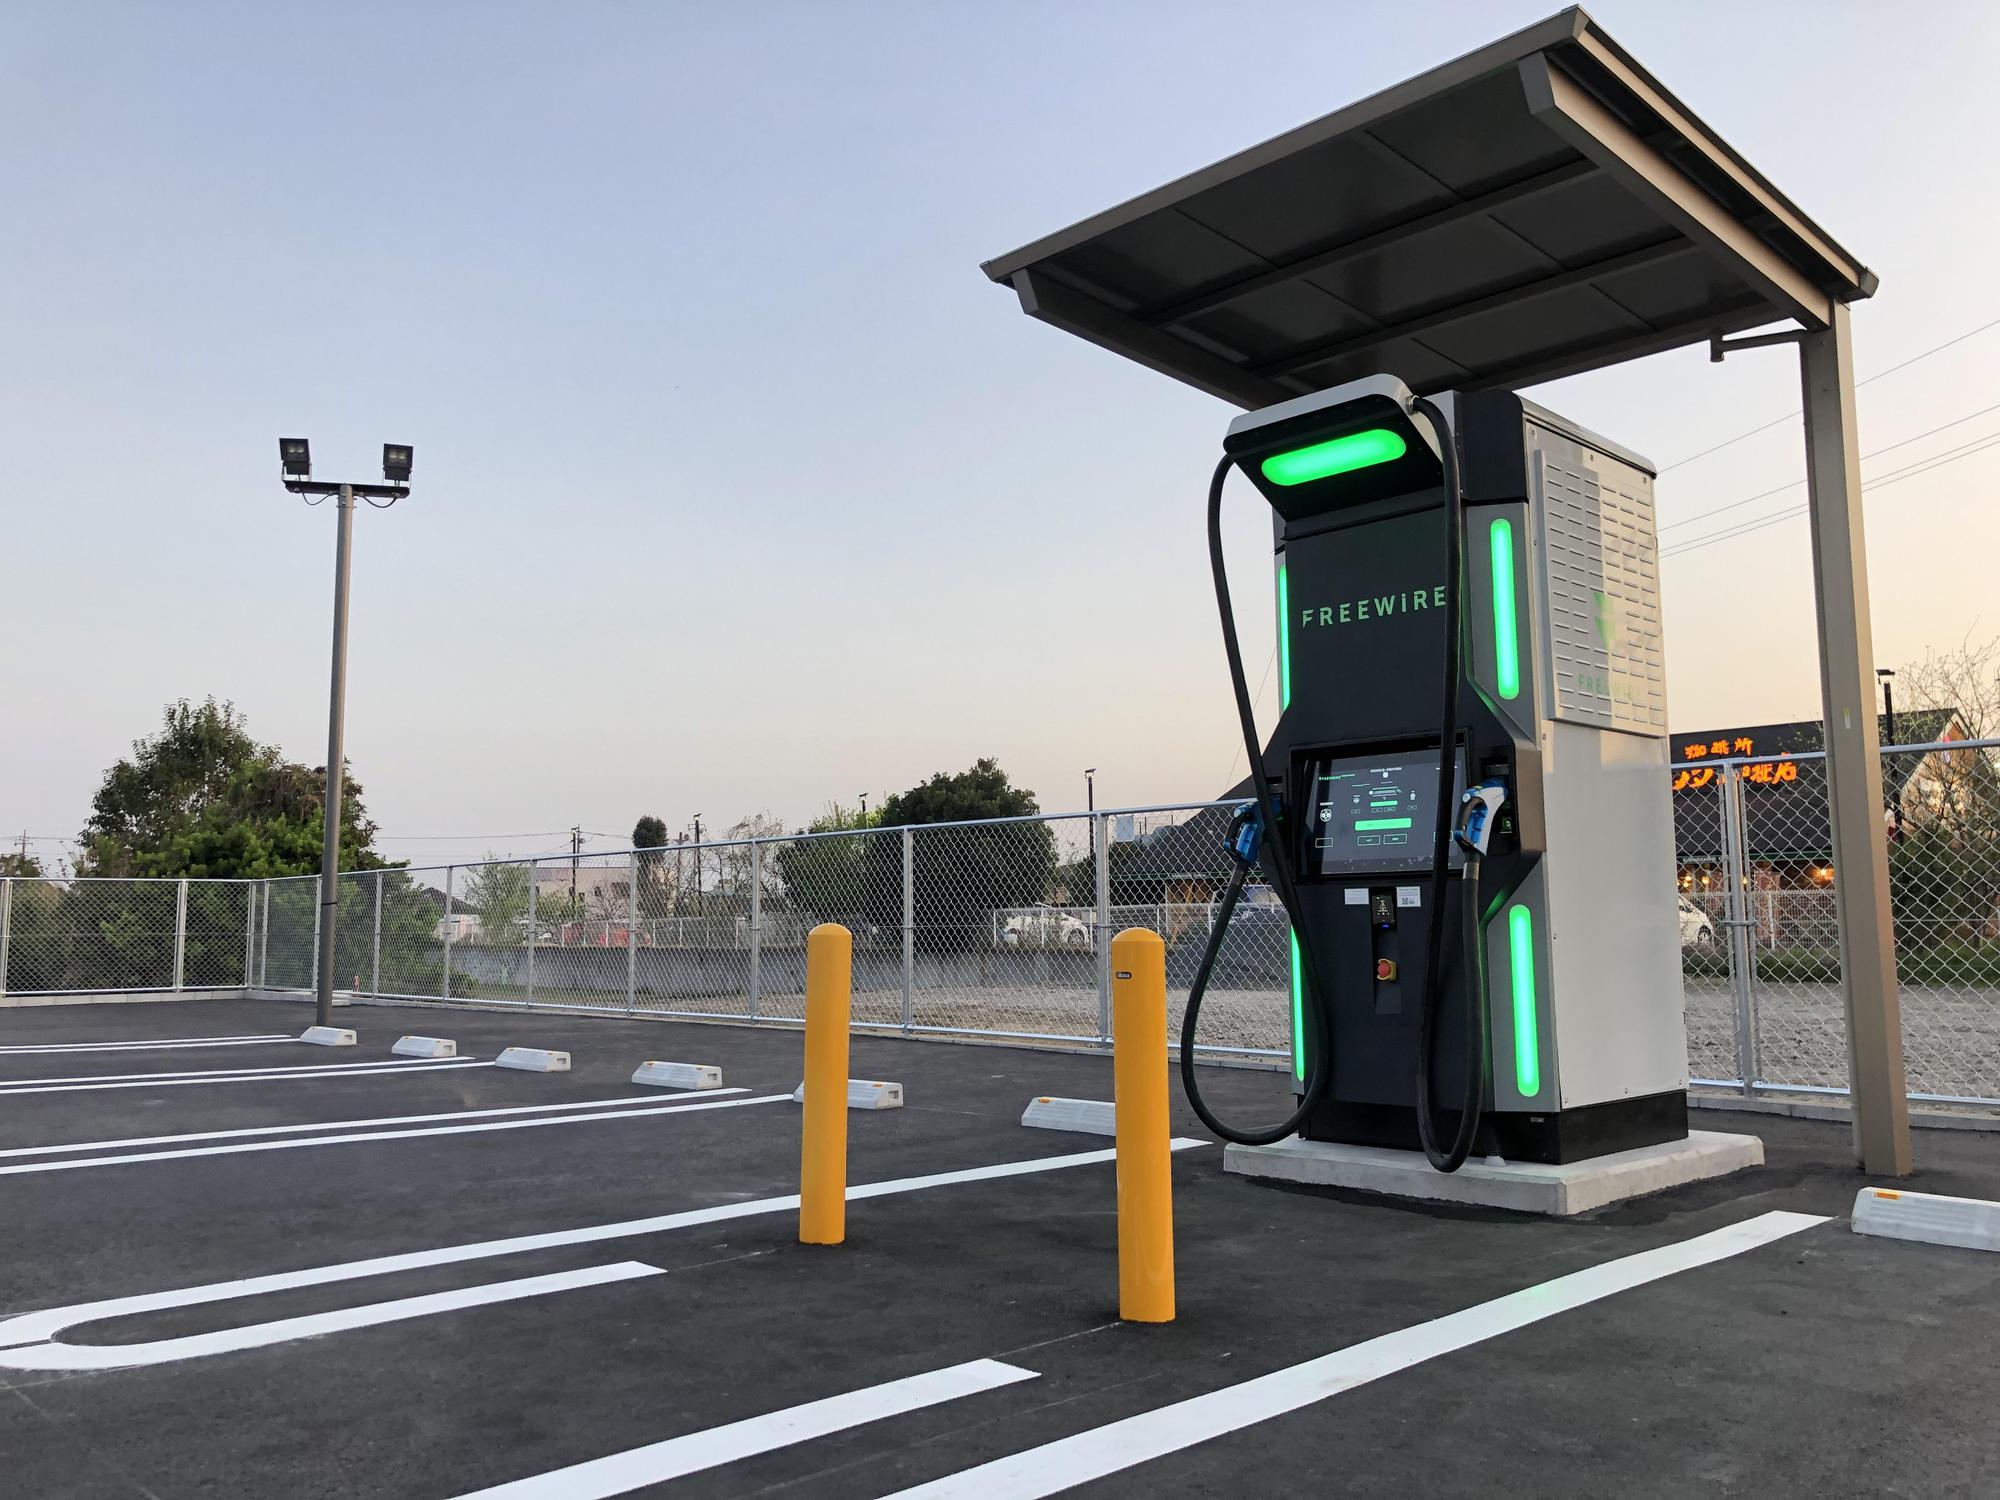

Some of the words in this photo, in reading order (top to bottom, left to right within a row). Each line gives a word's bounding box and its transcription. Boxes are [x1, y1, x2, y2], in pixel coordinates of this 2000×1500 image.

[1302, 585, 1447, 628] FREEWIRE
[1578, 674, 1641, 701] FREW
[1684, 737, 1754, 760] 珈琲所
